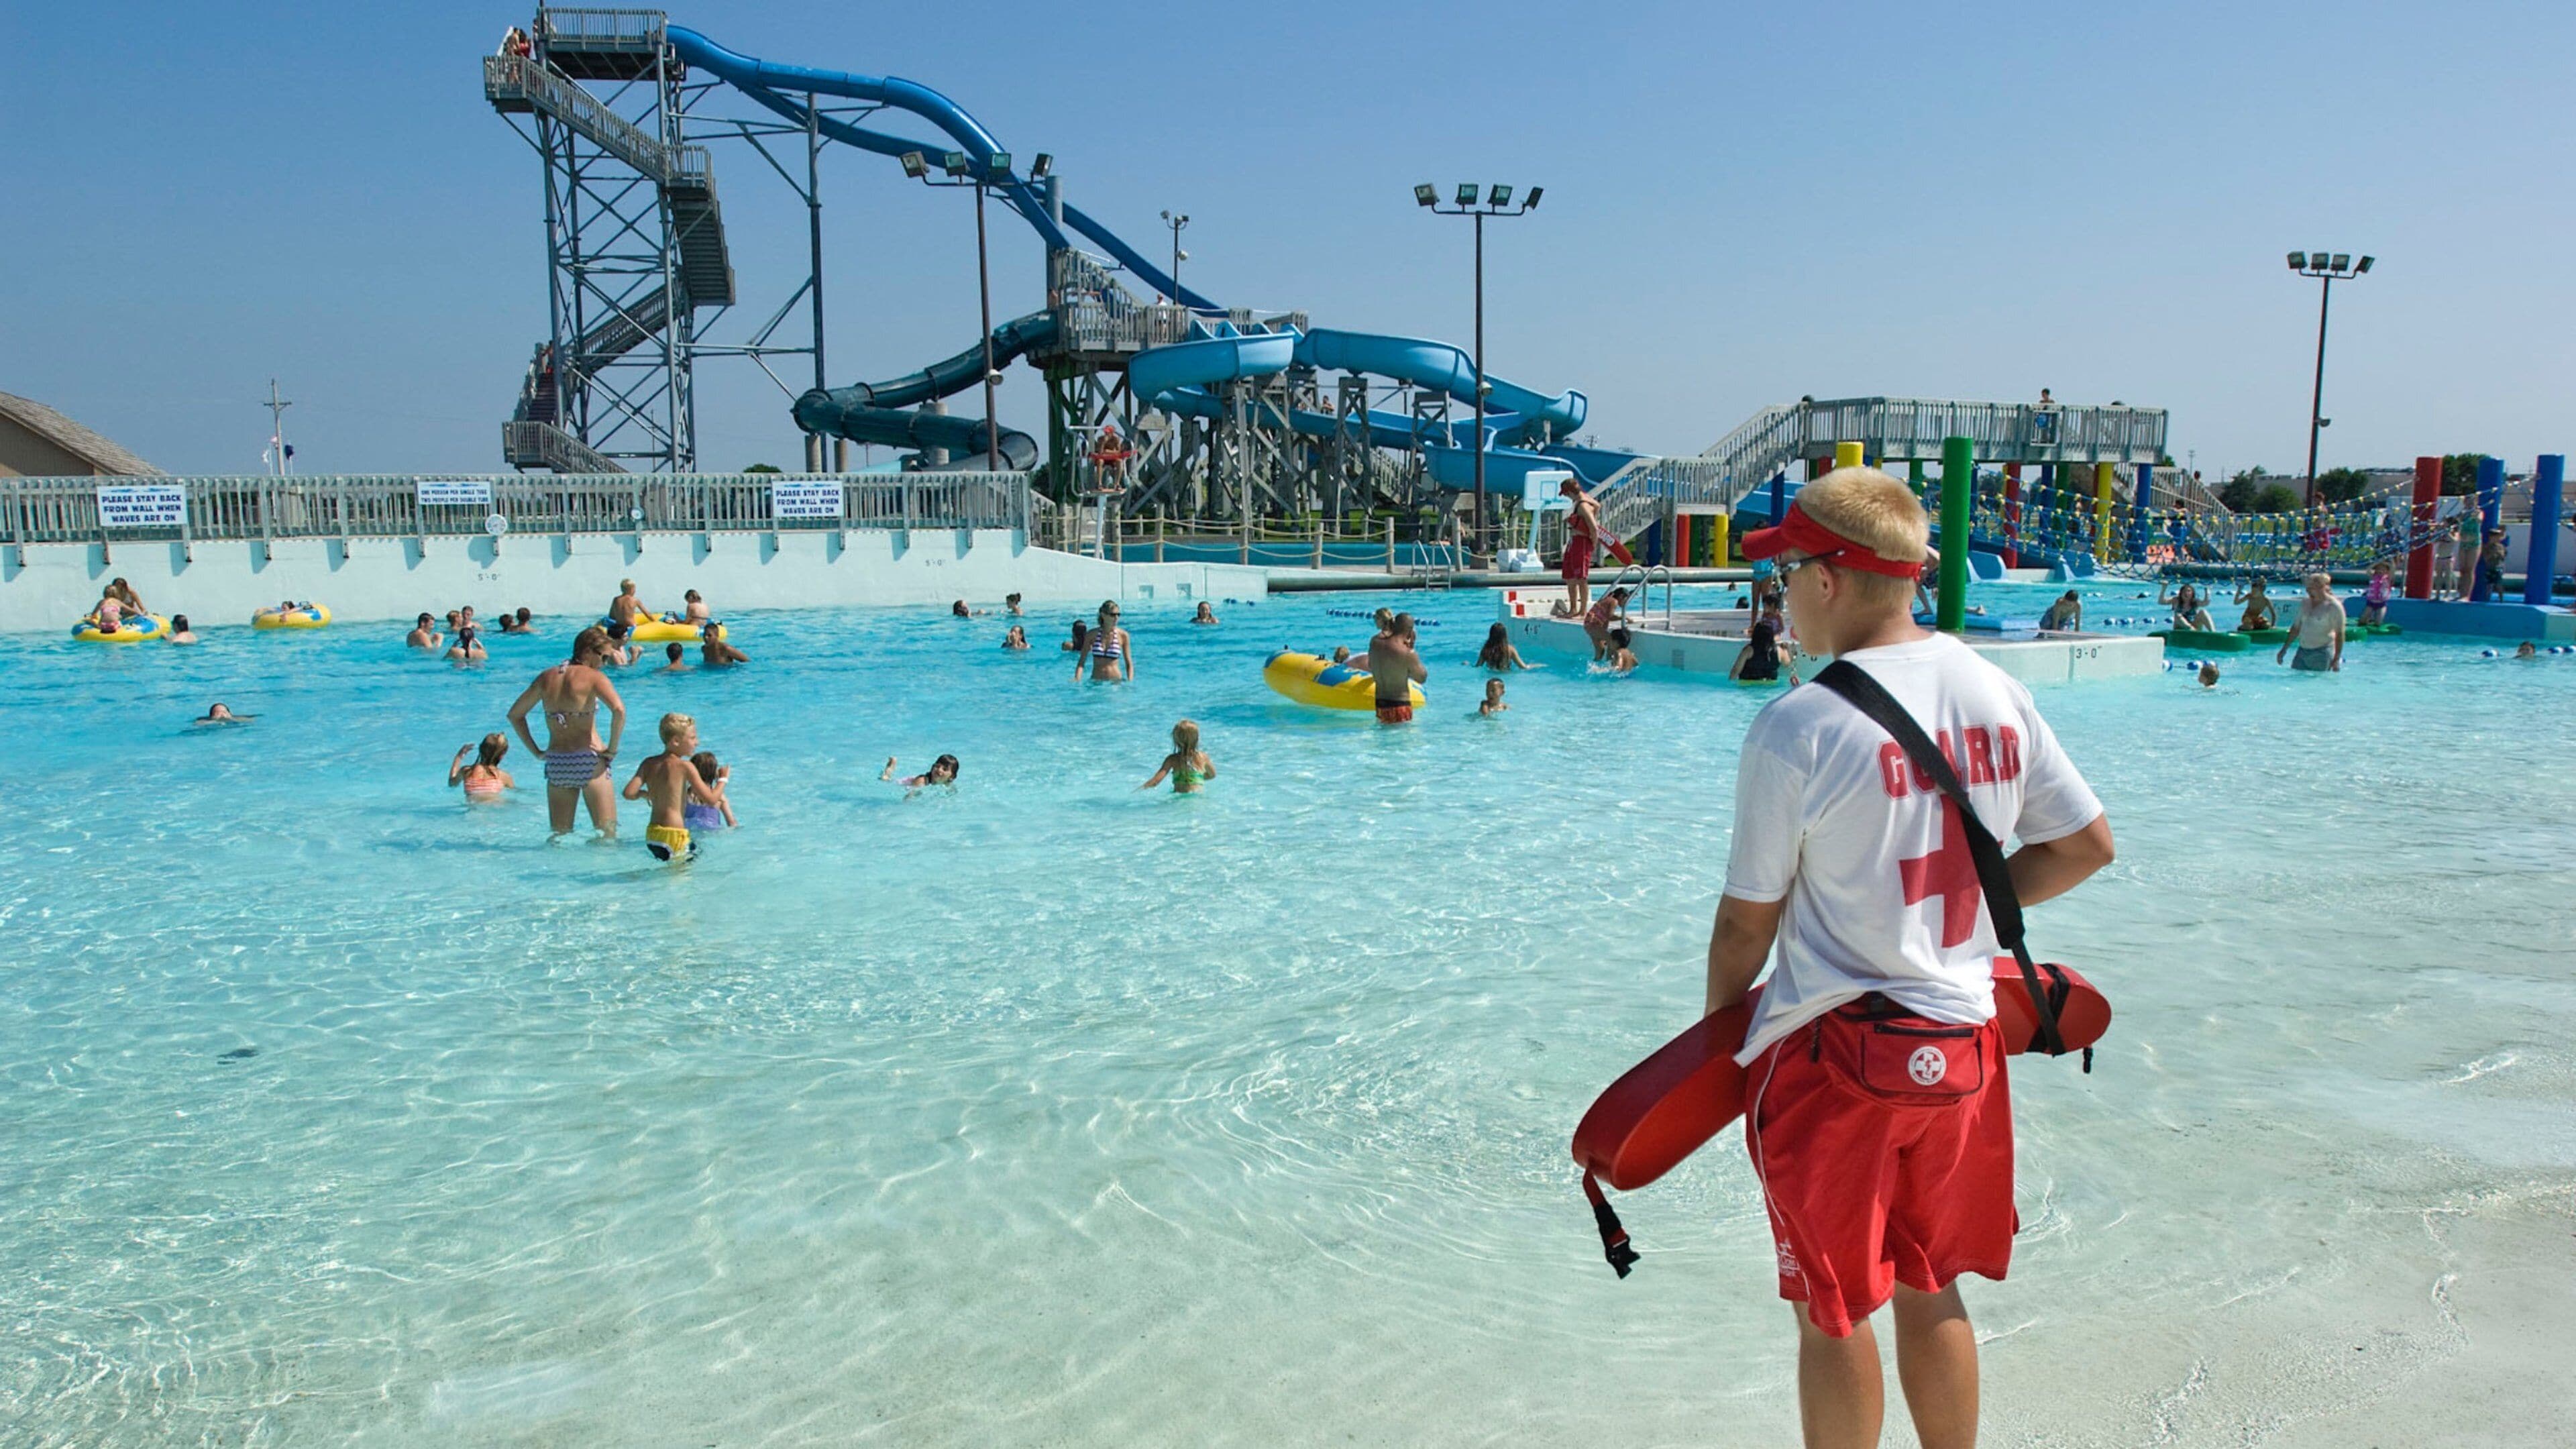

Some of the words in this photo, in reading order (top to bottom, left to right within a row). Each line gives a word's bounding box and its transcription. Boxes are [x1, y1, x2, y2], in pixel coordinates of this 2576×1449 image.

[102, 495, 132, 503] PLEASE
[103, 505, 128, 513] FROM
[111, 515, 140, 523] WAVES
